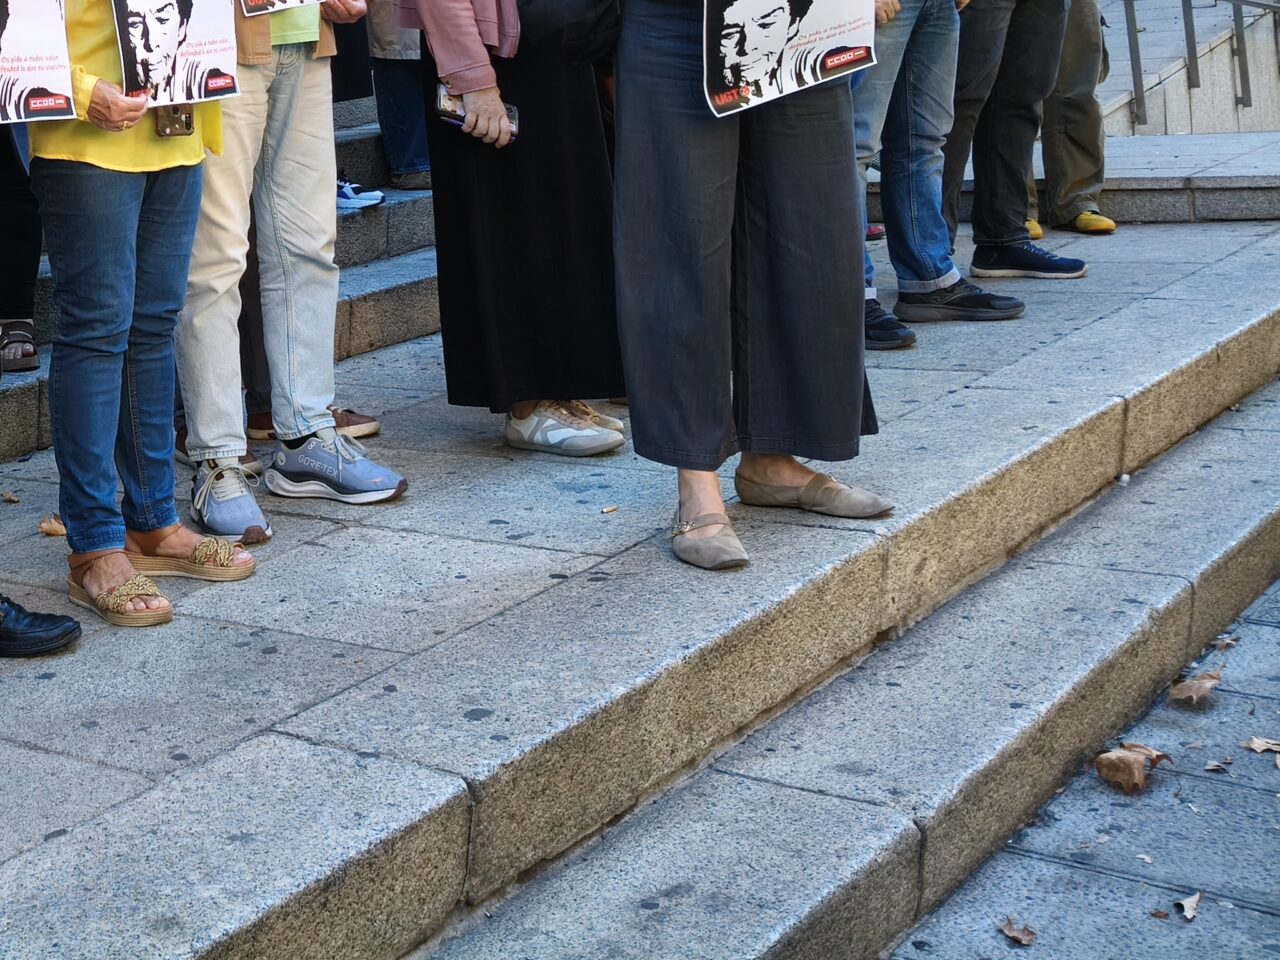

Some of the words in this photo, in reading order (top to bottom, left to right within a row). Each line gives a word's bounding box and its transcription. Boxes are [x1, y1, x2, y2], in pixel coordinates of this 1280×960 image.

[828, 52, 854, 66] CCOO
[31, 98, 55, 108] CCOO
[714, 88, 738, 106] UGT
[298, 454, 339, 479] GORE-TEX
